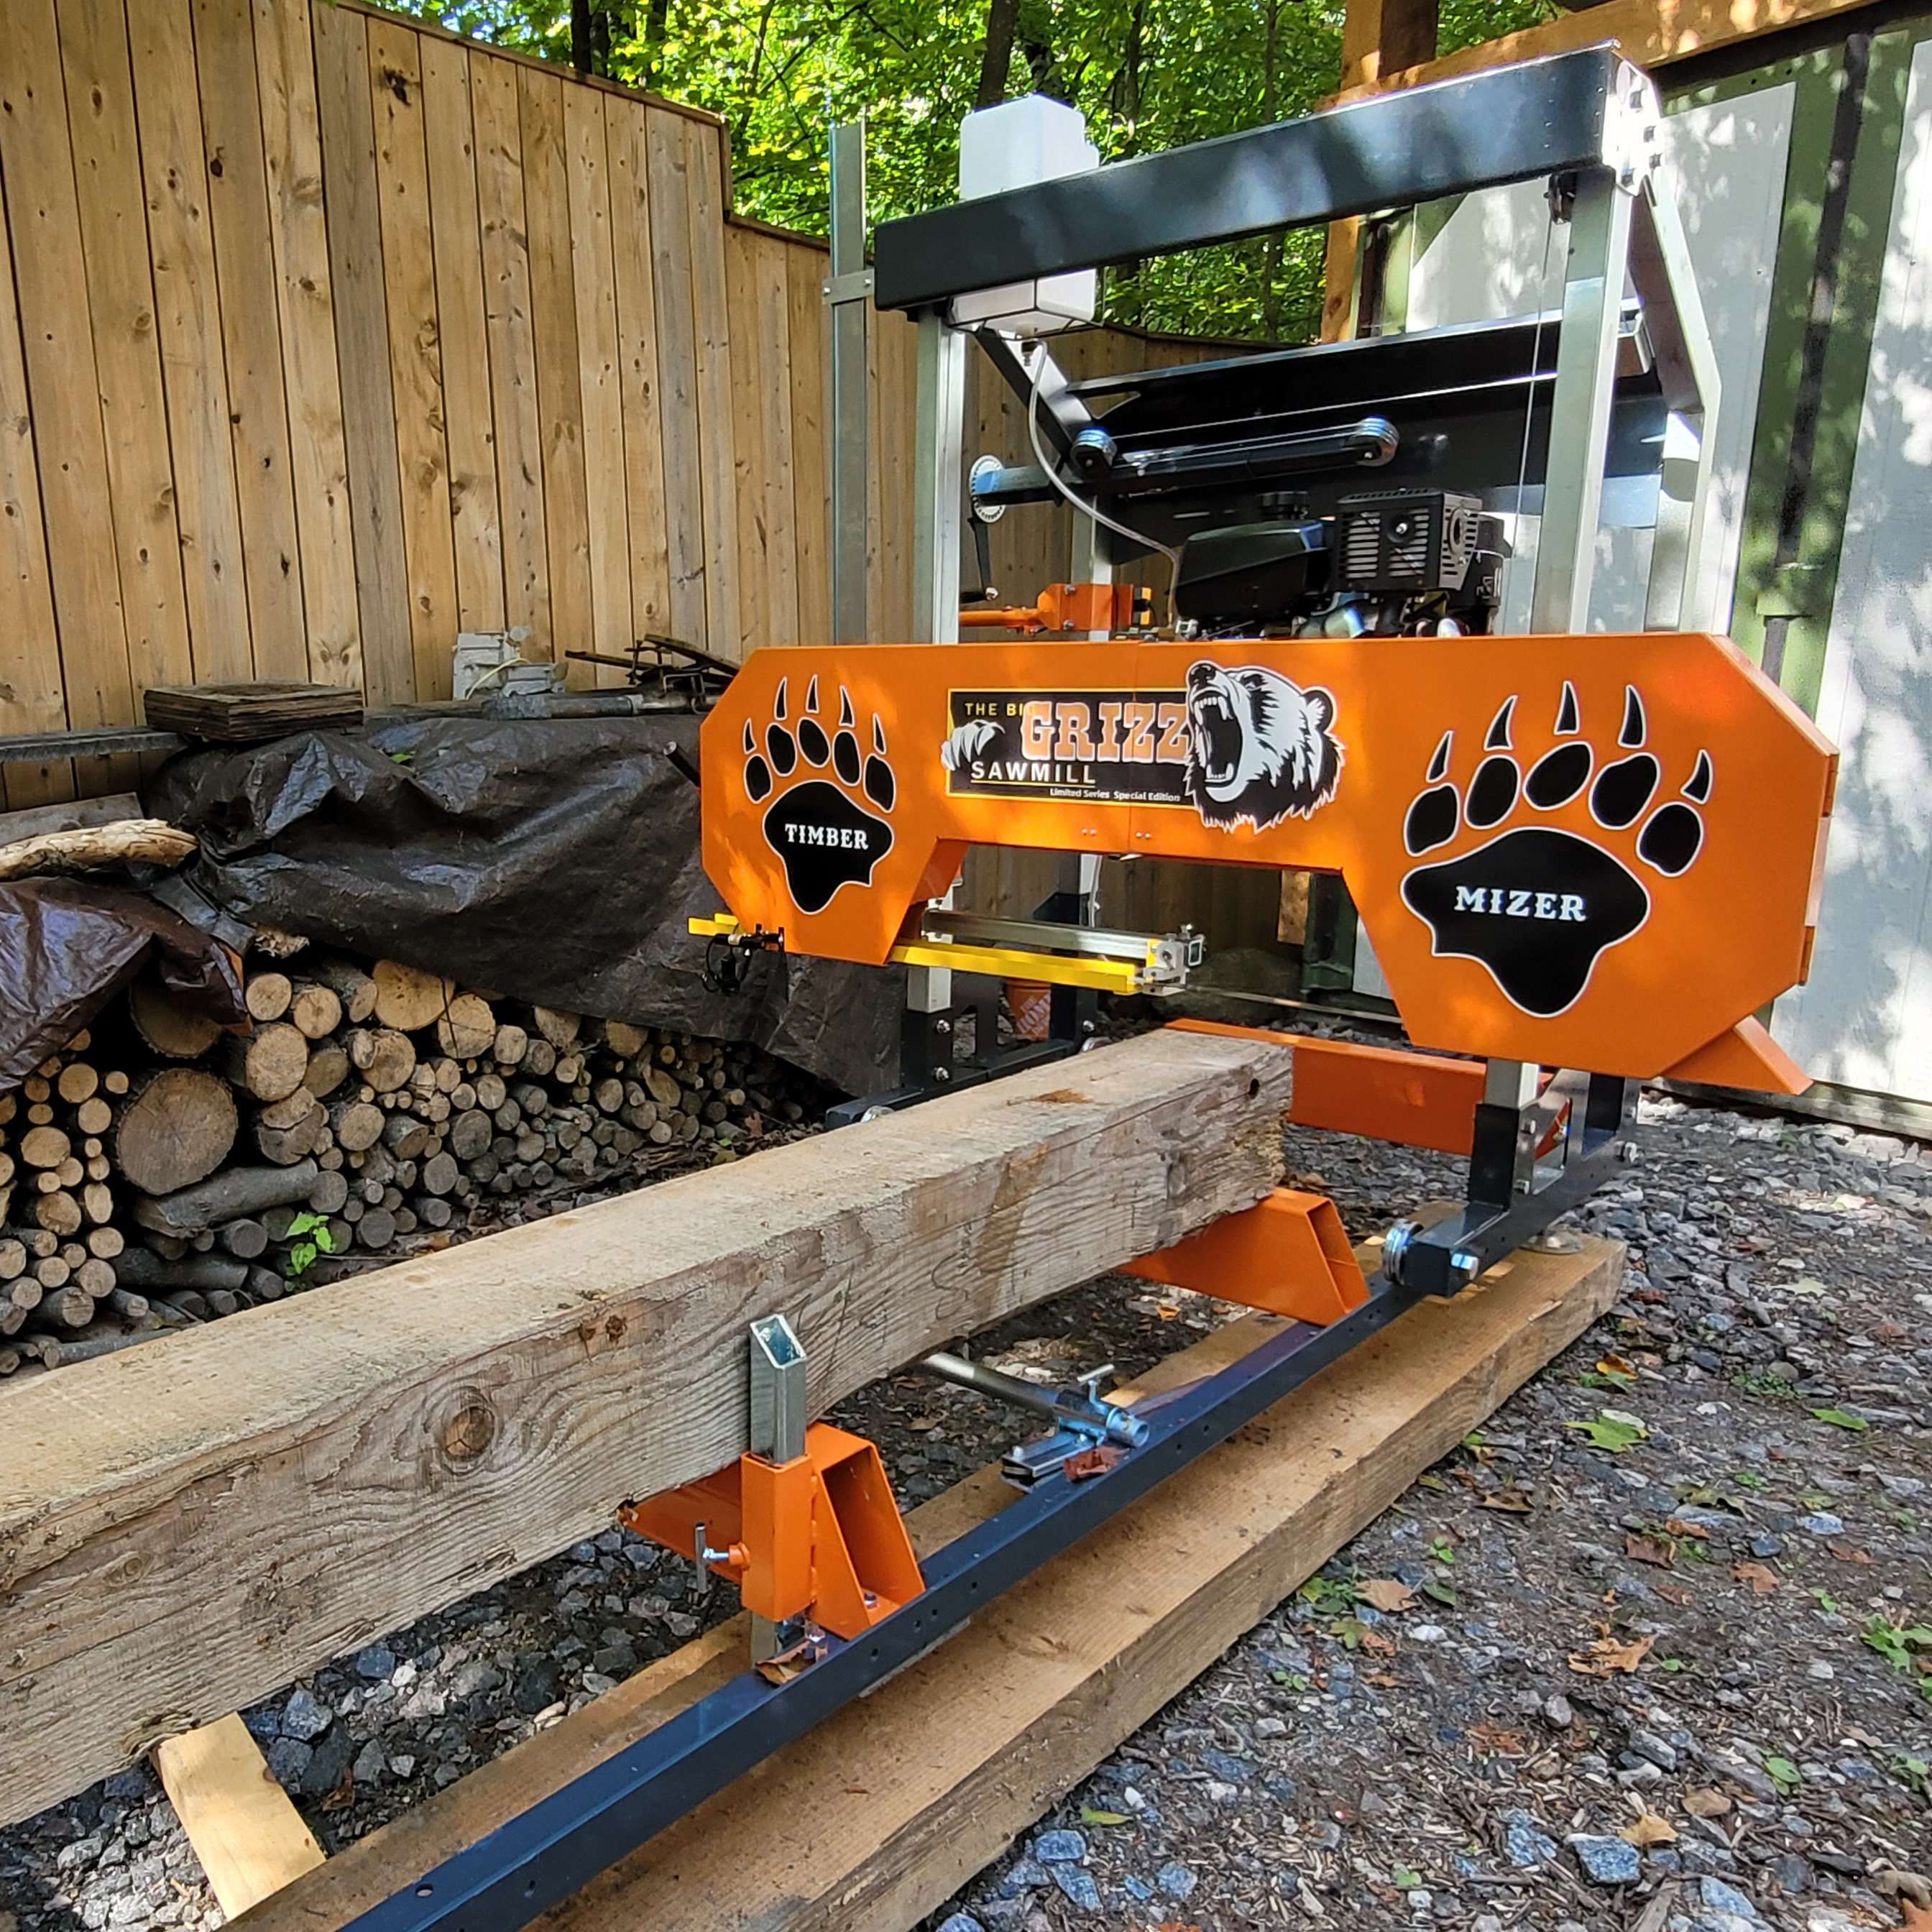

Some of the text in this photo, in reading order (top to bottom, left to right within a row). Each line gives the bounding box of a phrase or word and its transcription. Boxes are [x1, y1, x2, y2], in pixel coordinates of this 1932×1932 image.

[965, 703, 998, 716] THE
[1021, 701, 1189, 763] GRIZZ
[971, 761, 1095, 783] SAWMILL
[1114, 791, 1146, 801] Special
[1149, 793, 1180, 801] Edition
[785, 824, 868, 850] TIMBER
[1454, 886, 1587, 921] MIZER
